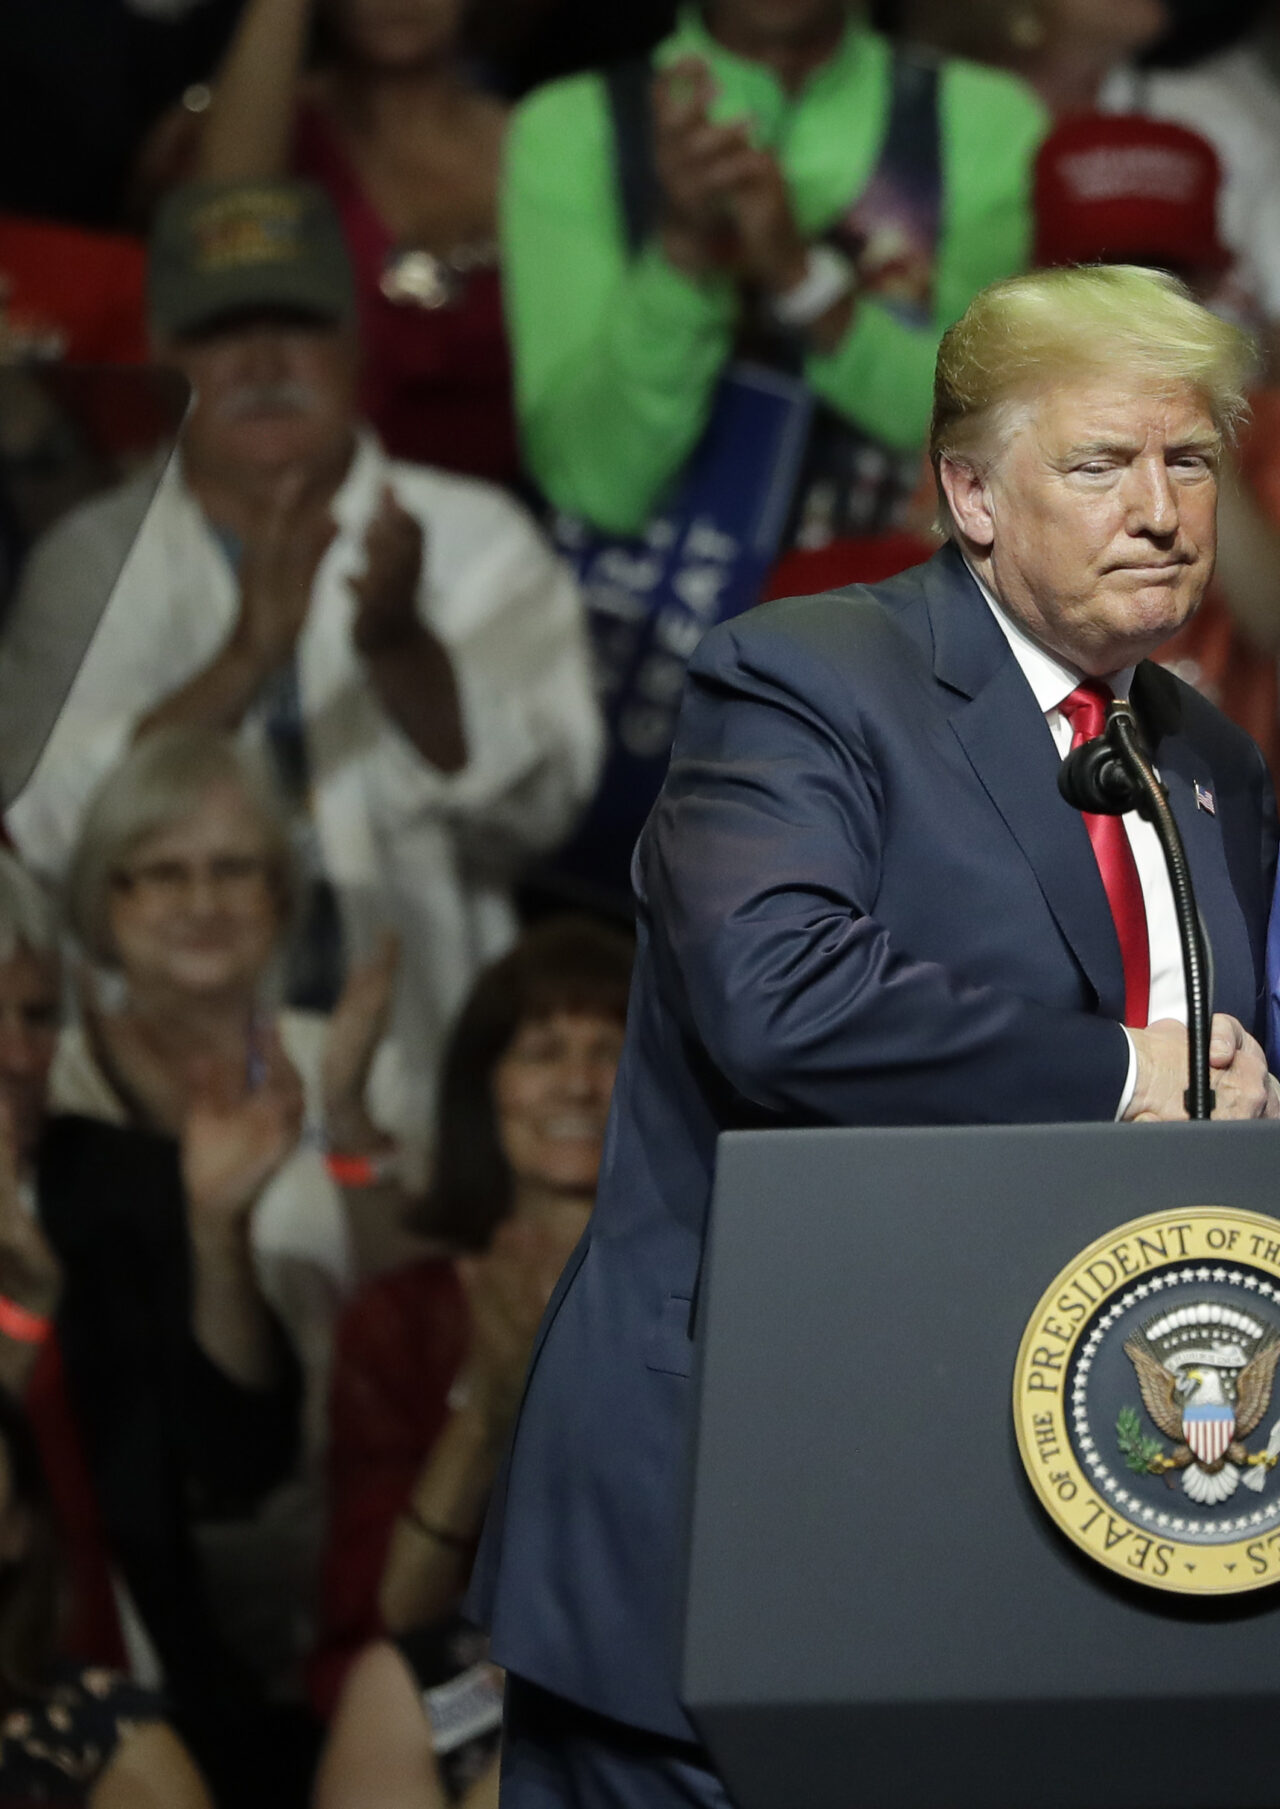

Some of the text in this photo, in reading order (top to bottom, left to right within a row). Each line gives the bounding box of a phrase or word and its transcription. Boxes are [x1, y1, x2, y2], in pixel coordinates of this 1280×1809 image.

[1206, 1228, 1240, 1250] OF
[1027, 1224, 1192, 1393] PRESIDENT
[1033, 1411, 1060, 1464] THE
[1049, 1471, 1078, 1502] OF
[1080, 1499, 1175, 1576] SEAL
